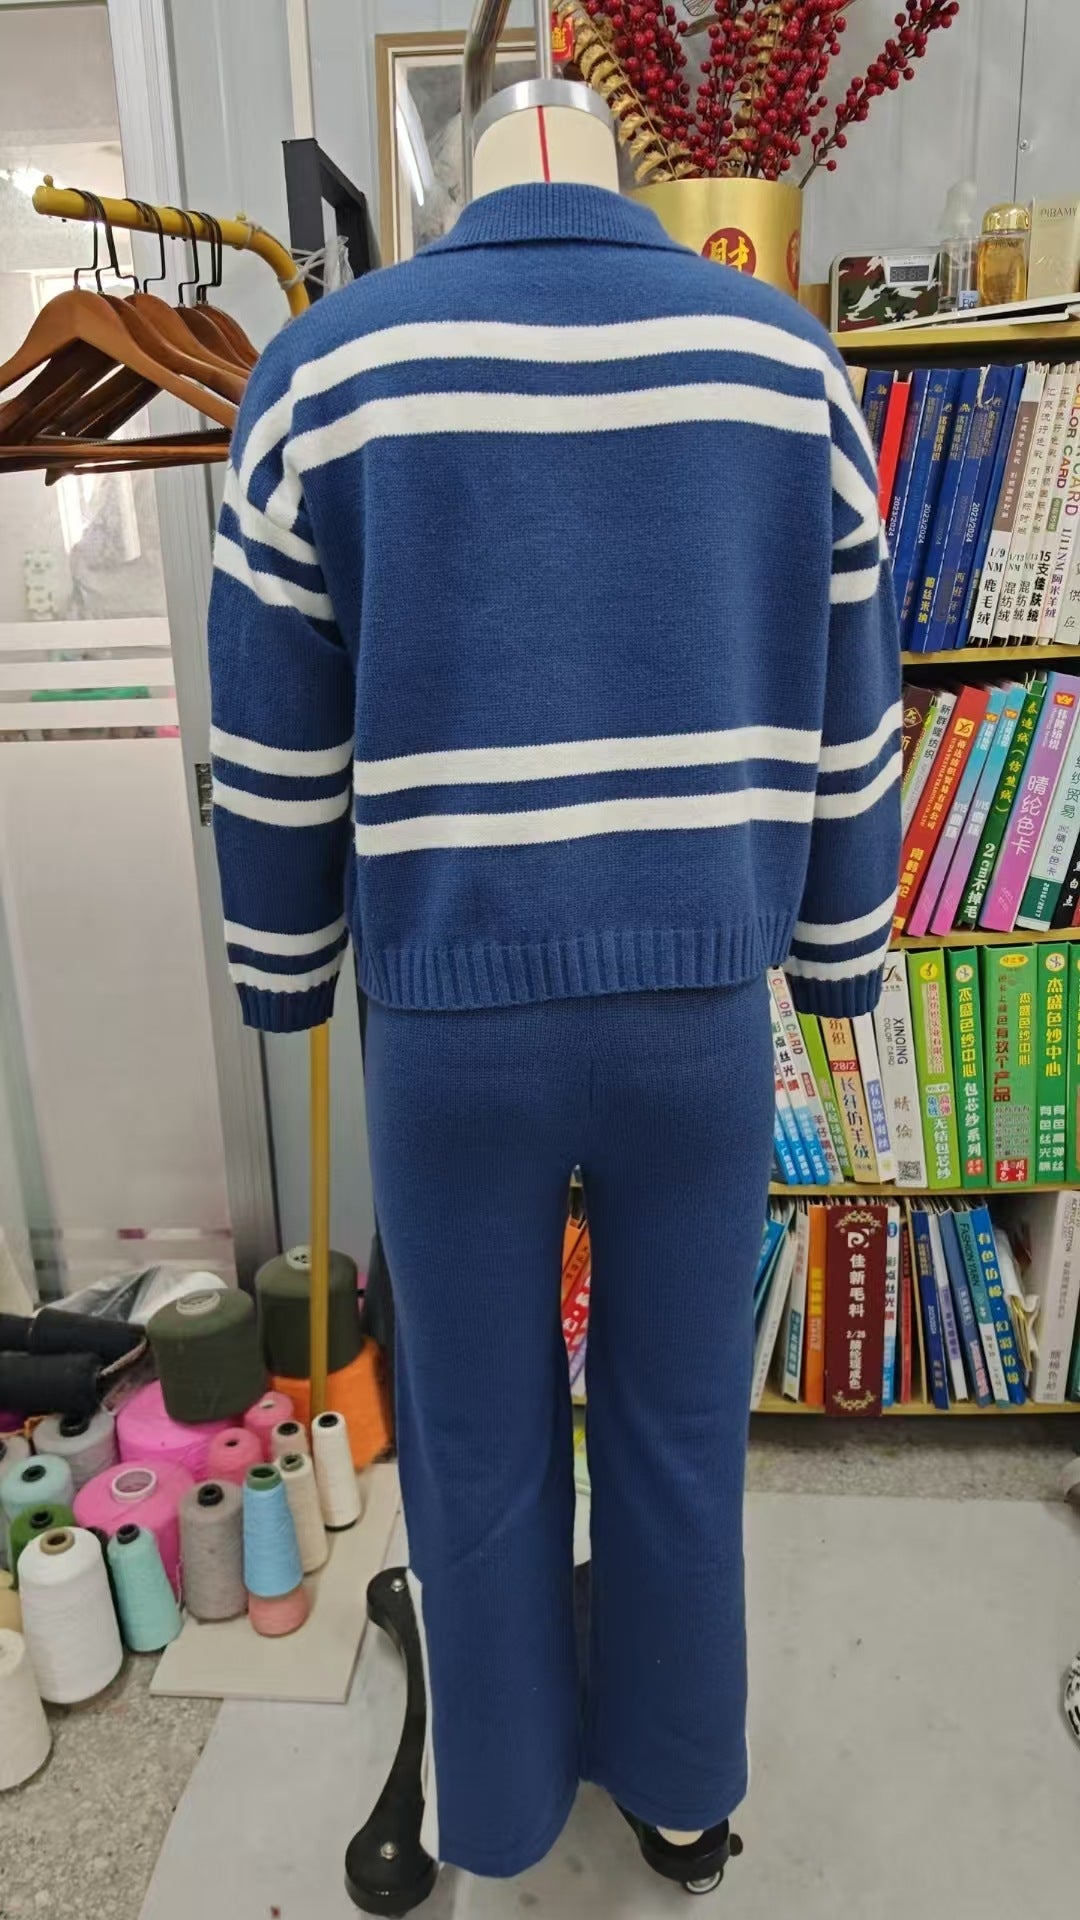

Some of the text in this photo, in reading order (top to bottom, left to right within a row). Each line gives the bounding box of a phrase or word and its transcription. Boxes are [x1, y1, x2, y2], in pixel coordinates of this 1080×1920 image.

[709, 236, 750, 273] 财
[1057, 445, 1073, 489] CARD
[888, 496, 901, 537] 2023/2024
[918, 504, 931, 544] 2023/2024
[966, 502, 980, 542] 2023/2024
[986, 561, 1003, 572] NM
[990, 547, 1006, 558] 1/9
[976, 578, 997, 626] 鹿毛绒
[997, 581, 1016, 623] 混纺绒
[1012, 580, 1031, 621] 混纺绒
[1010, 775, 1049, 856] 晴纶色卡
[893, 1018, 909, 1065] XINQING
[1045, 977, 1064, 1077] 杰盛色纱中心
[832, 1061, 856, 1071] 28/2
[965, 1082, 982, 1158] 包芯纱系列
[934, 1118, 951, 1180] 无结包芯纱
[960, 1223, 980, 1287] FASHION YARN
[848, 1254, 866, 1318] 佳新毛料
